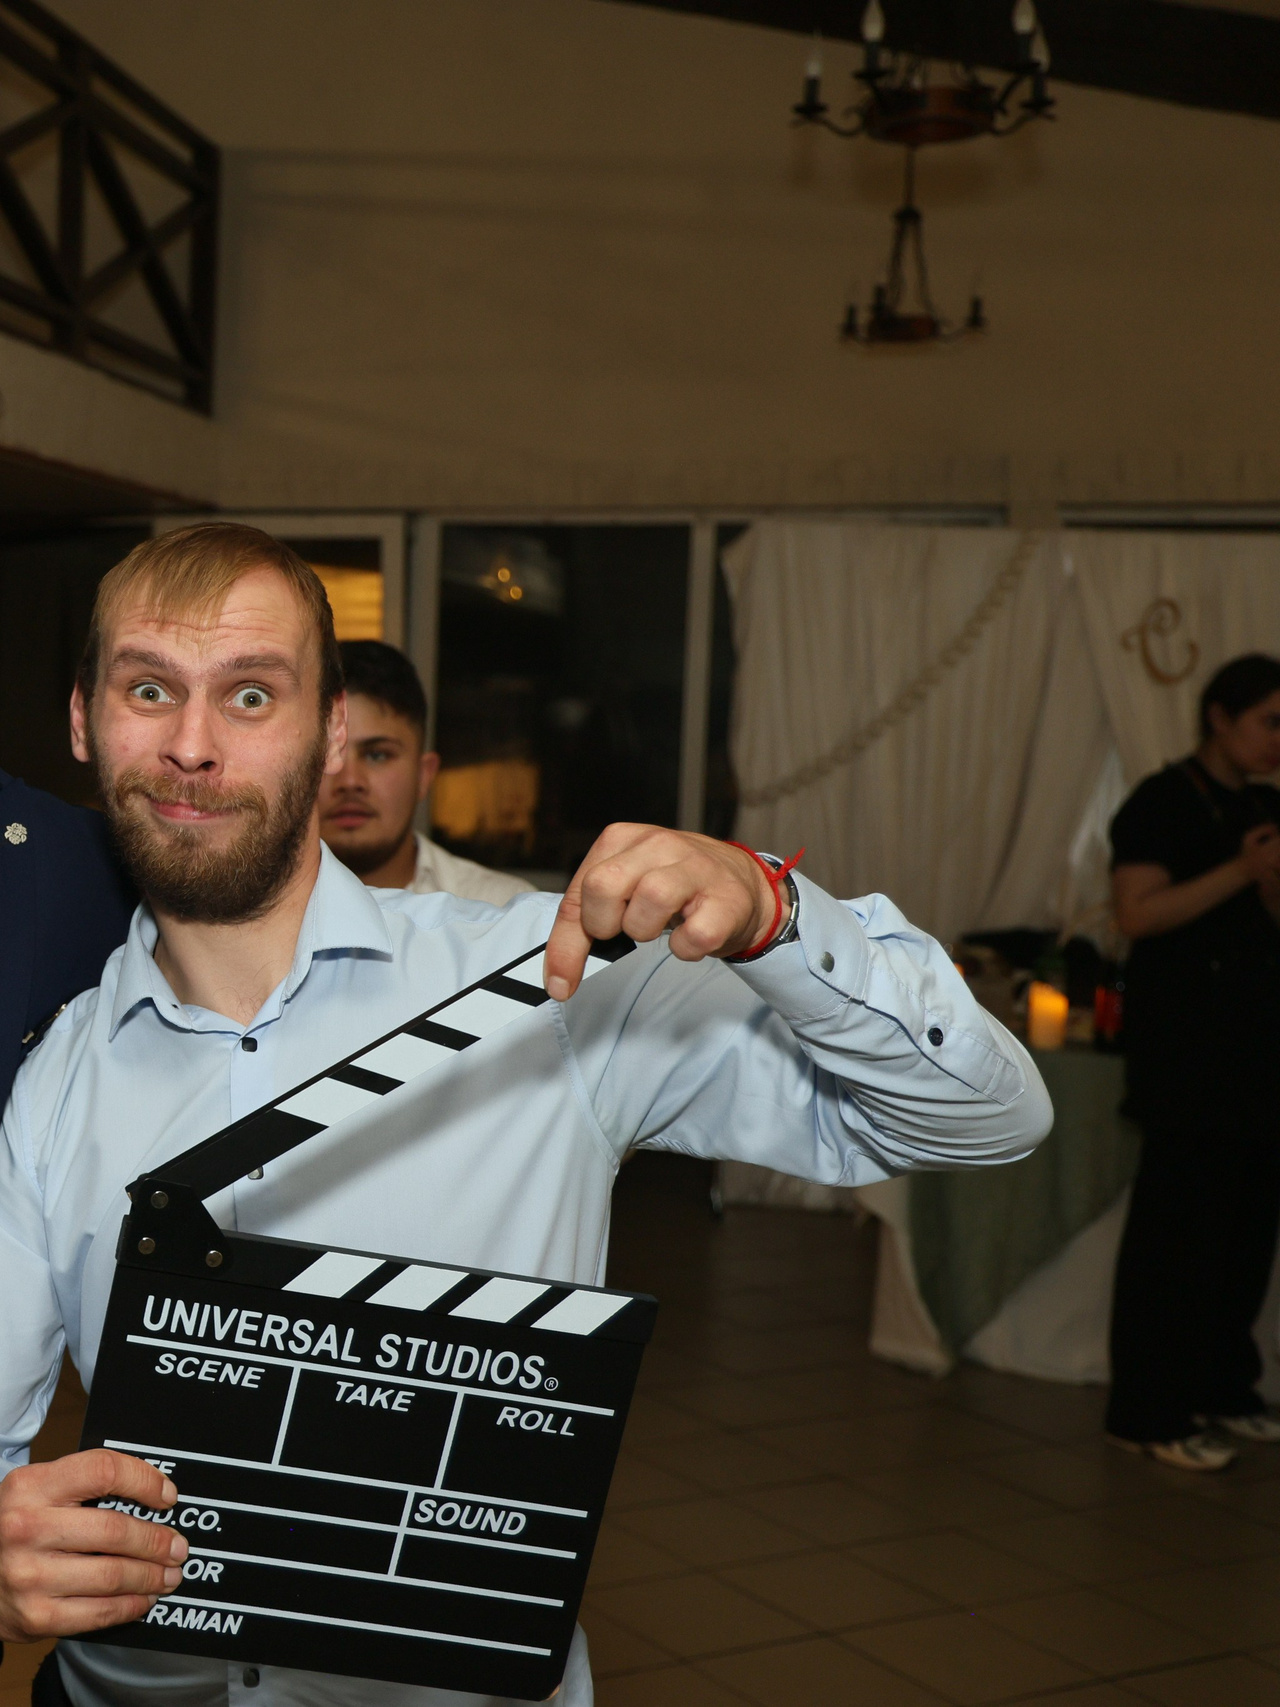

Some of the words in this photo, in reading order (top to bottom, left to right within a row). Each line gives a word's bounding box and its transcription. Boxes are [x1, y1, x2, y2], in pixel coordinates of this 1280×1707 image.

[142, 1294, 362, 1364] UNIVERSAL
[154, 1353, 266, 1389] SCENE
[335, 1380, 416, 1412] TAKE
[496, 1406, 575, 1437] ROLL
[414, 1498, 527, 1536] SOUND
[141, 1603, 244, 1635] RAMAN
